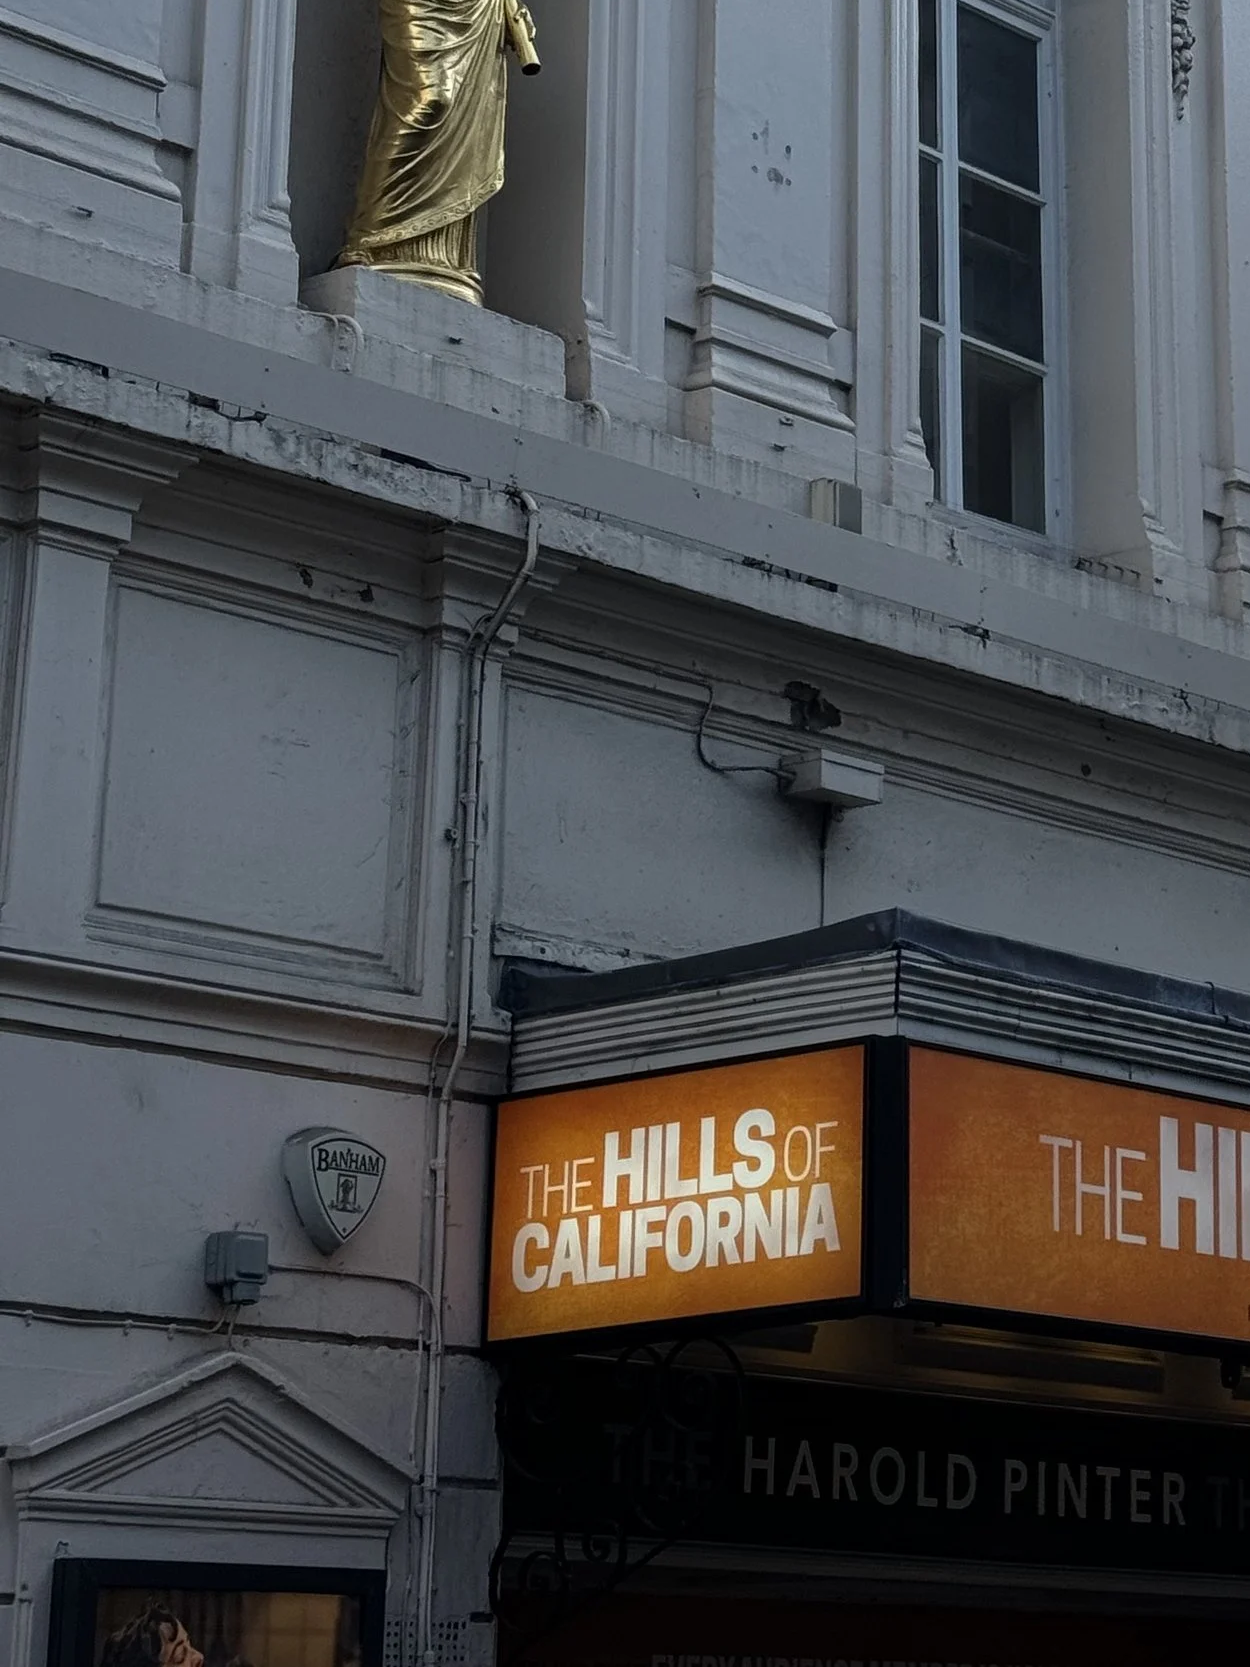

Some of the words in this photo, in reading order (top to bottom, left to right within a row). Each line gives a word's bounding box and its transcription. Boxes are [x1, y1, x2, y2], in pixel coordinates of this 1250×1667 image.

[317, 1148, 380, 1174] BANHAM
[520, 1157, 596, 1219] THE
[602, 1108, 776, 1209] HILLS
[784, 1121, 839, 1182] OF
[1039, 1135, 1148, 1246] THE
[512, 1183, 841, 1293] CALIFORNIA
[603, 1423, 713, 1490] THE
[743, 1435, 978, 1510] HAROLD
[1004, 1458, 1187, 1526] PINTER
